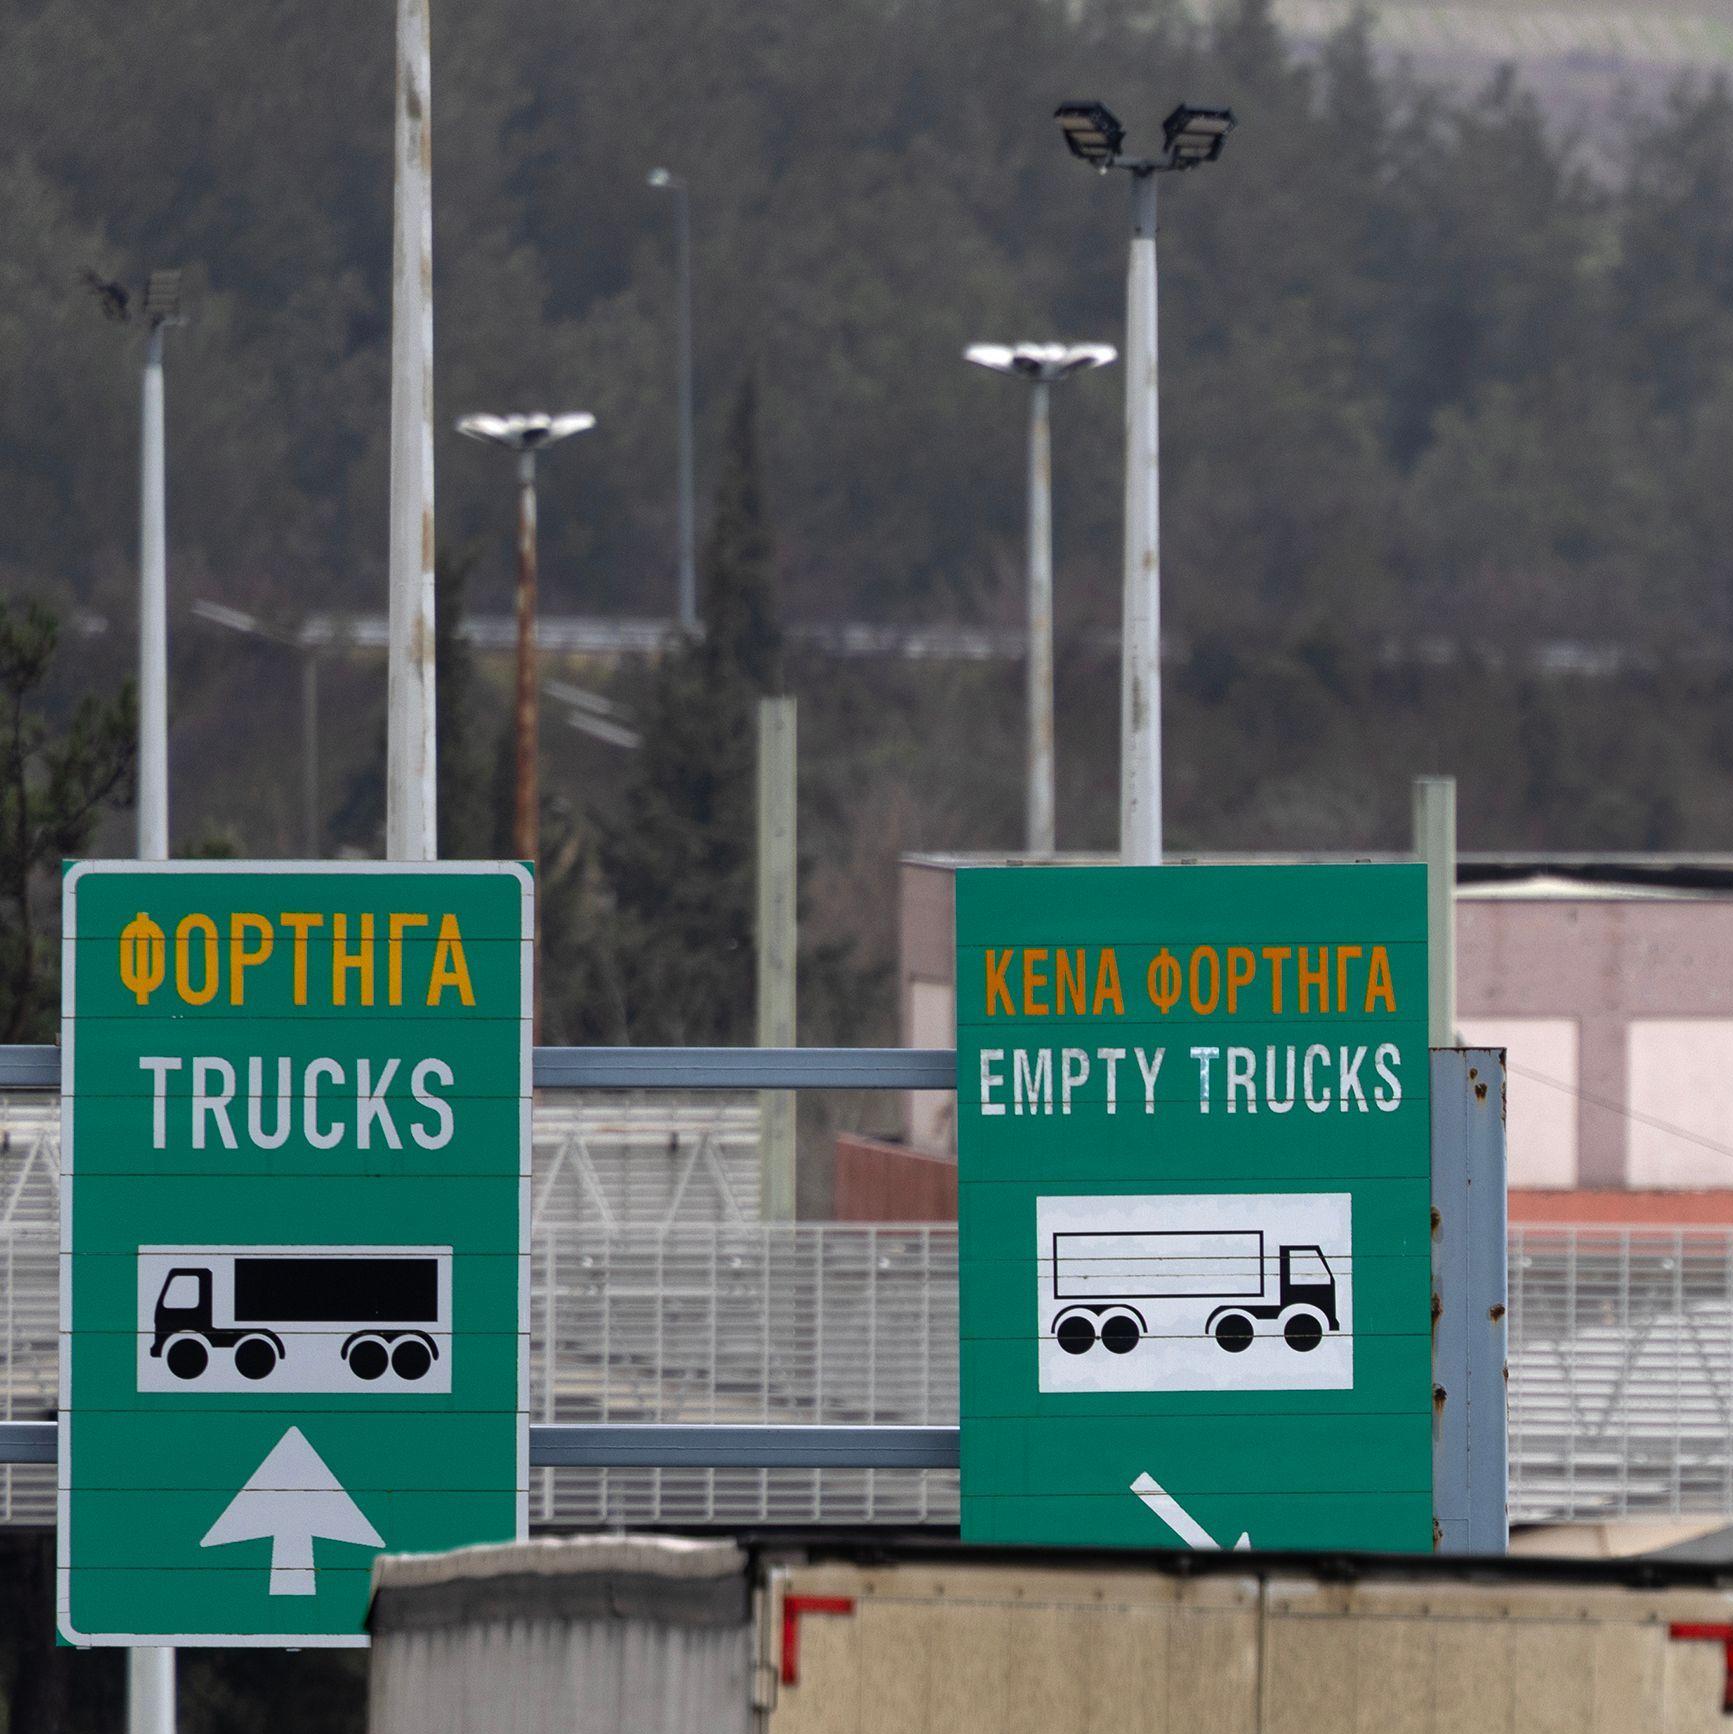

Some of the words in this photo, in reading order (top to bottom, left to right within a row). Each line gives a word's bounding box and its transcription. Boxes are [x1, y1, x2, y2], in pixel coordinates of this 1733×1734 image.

[119, 912, 477, 1007] ΦΟΡΤΗΓΑ
[984, 947, 1126, 1016] ΚΕΝΑ
[1147, 945, 1397, 1015] ΦΟΡΤΗΓΑ
[139, 1056, 455, 1150] TRUCKS
[980, 1046, 1166, 1115] EMPTY
[1189, 1042, 1403, 1114] TRUCKS
